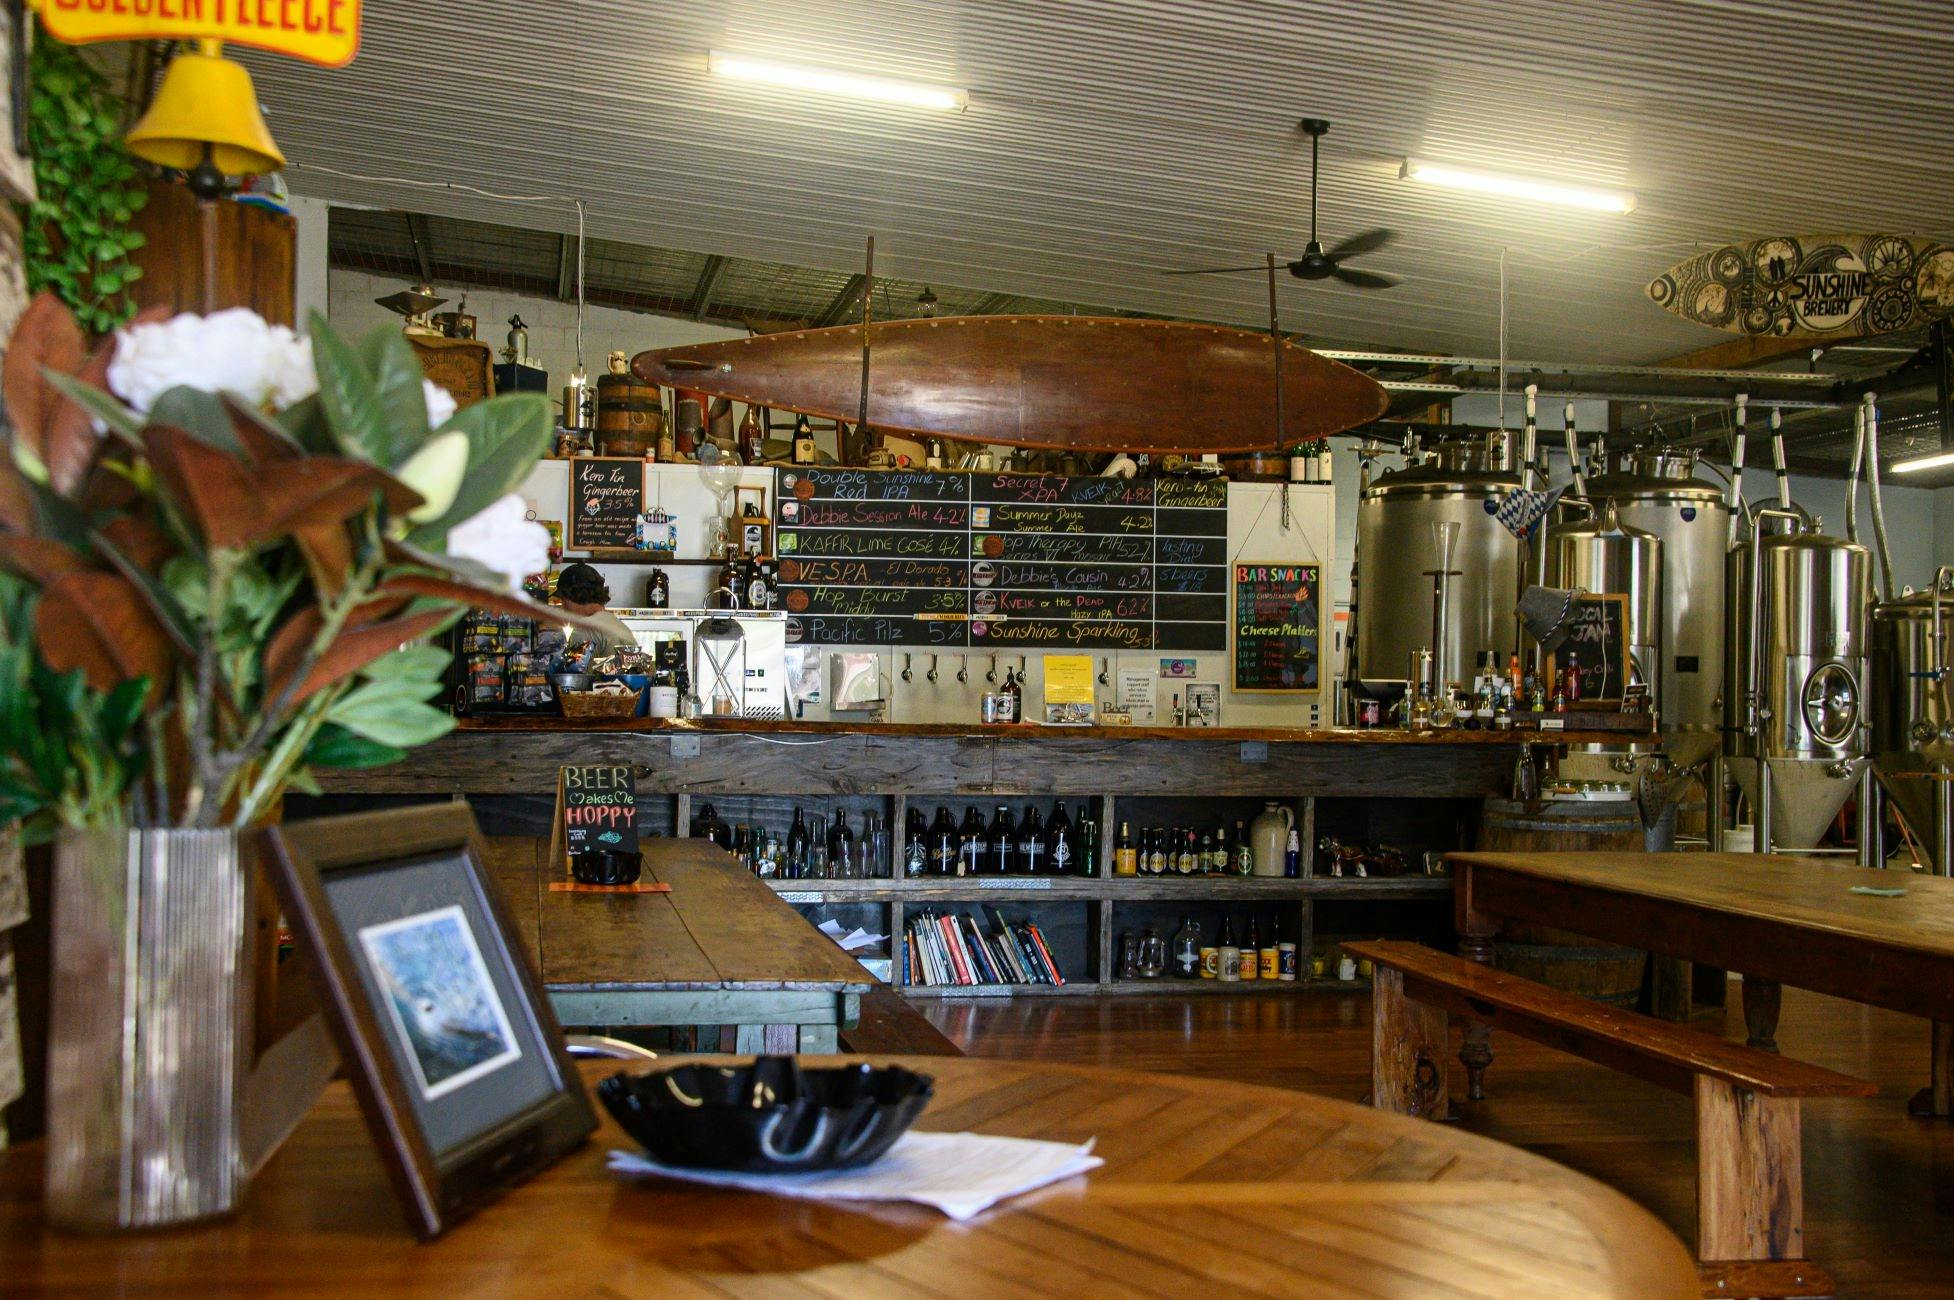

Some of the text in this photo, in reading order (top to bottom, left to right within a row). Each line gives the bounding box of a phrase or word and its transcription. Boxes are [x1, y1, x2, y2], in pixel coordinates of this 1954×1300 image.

[1791, 272, 1871, 299] SUNSHINE
[1803, 299, 1850, 317] BREWERY
[580, 464, 625, 483] Kero Tin
[807, 470, 867, 484] Double
[873, 472, 935, 485] Sunshine
[583, 484, 639, 500] Gingerbeer
[834, 484, 910, 499] Red IPA
[993, 476, 1068, 492] Secret 7
[1018, 489, 1059, 502] XPA
[800, 504, 849, 526] Debbie
[853, 503, 902, 523] Session
[908, 504, 928, 520] Ale
[996, 505, 1052, 520] Summer
[1014, 523, 1085, 533] Summer Ale
[800, 534, 852, 553] KAFFIR
[858, 538, 892, 553] LIME
[1028, 534, 1086, 554] Therapy
[905, 561, 949, 575] Dorado
[1066, 567, 1108, 584] Cousin
[1237, 567, 1316, 582] BAR SNACKS
[814, 587, 845, 606] Hop
[860, 588, 910, 602] Burst
[1000, 592, 1034, 609] KVEIK
[1055, 597, 1071, 607] the
[810, 618, 962, 643] Pacific Pilz 5%
[990, 621, 1139, 645] Sunshine Sparkling
[1240, 625, 1279, 636] Cheese
[566, 766, 628, 788] BEER
[566, 805, 636, 828] HOPPY
